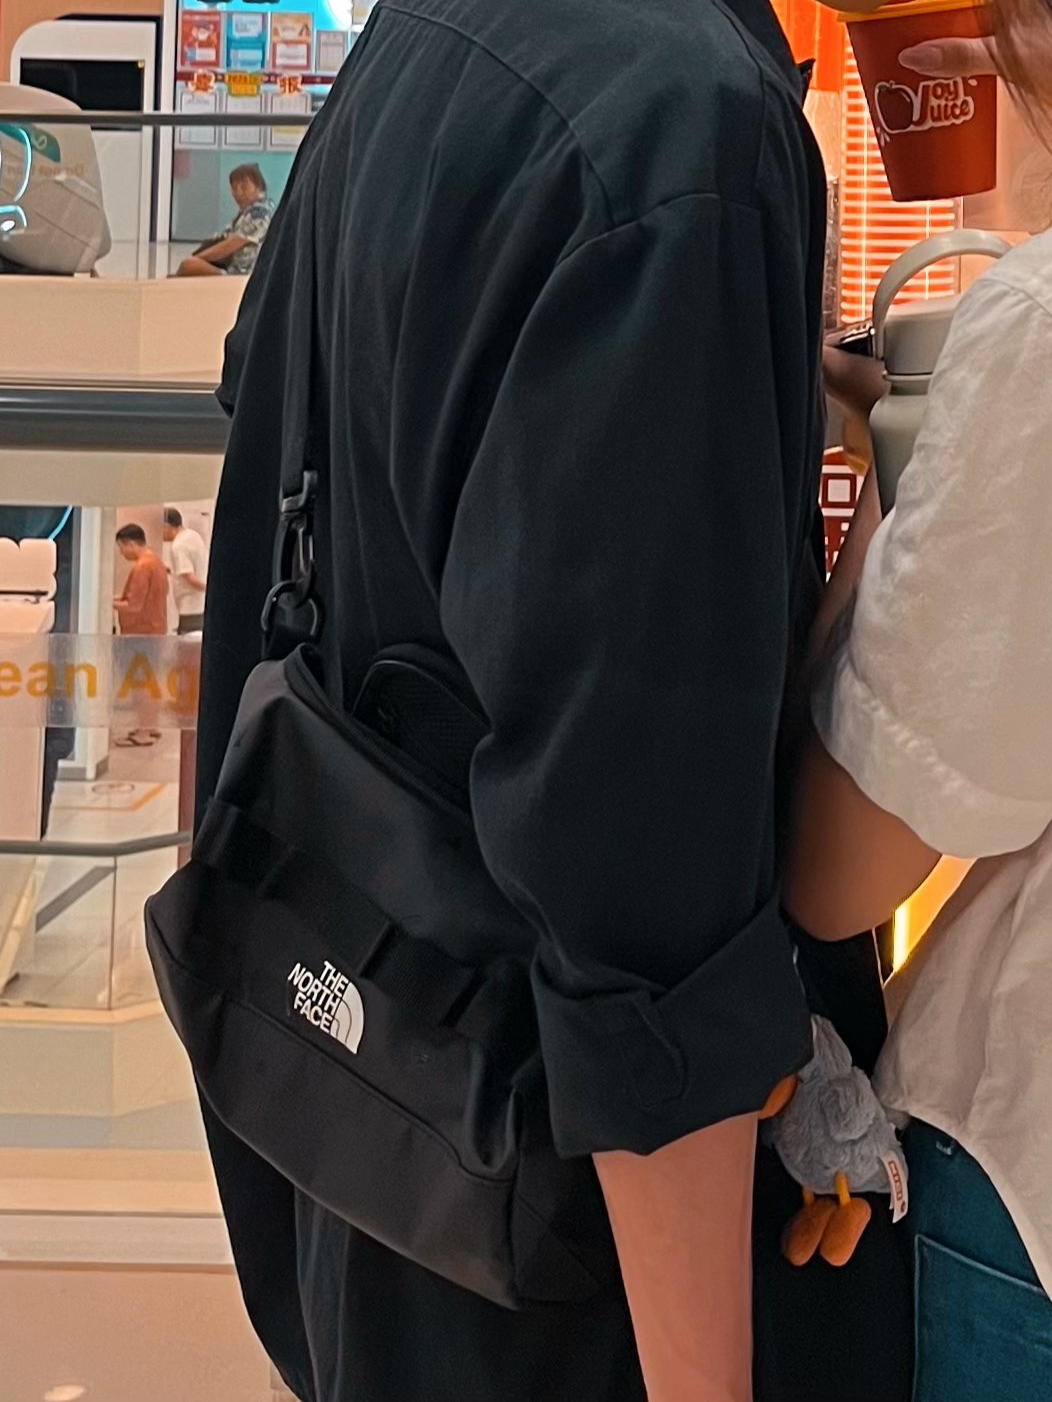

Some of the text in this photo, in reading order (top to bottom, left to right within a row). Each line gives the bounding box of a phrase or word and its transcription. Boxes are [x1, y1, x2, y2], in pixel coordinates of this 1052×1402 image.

[287, 962, 341, 1016] NORTH
[319, 960, 350, 998] THE
[293, 991, 333, 1034] FACE
